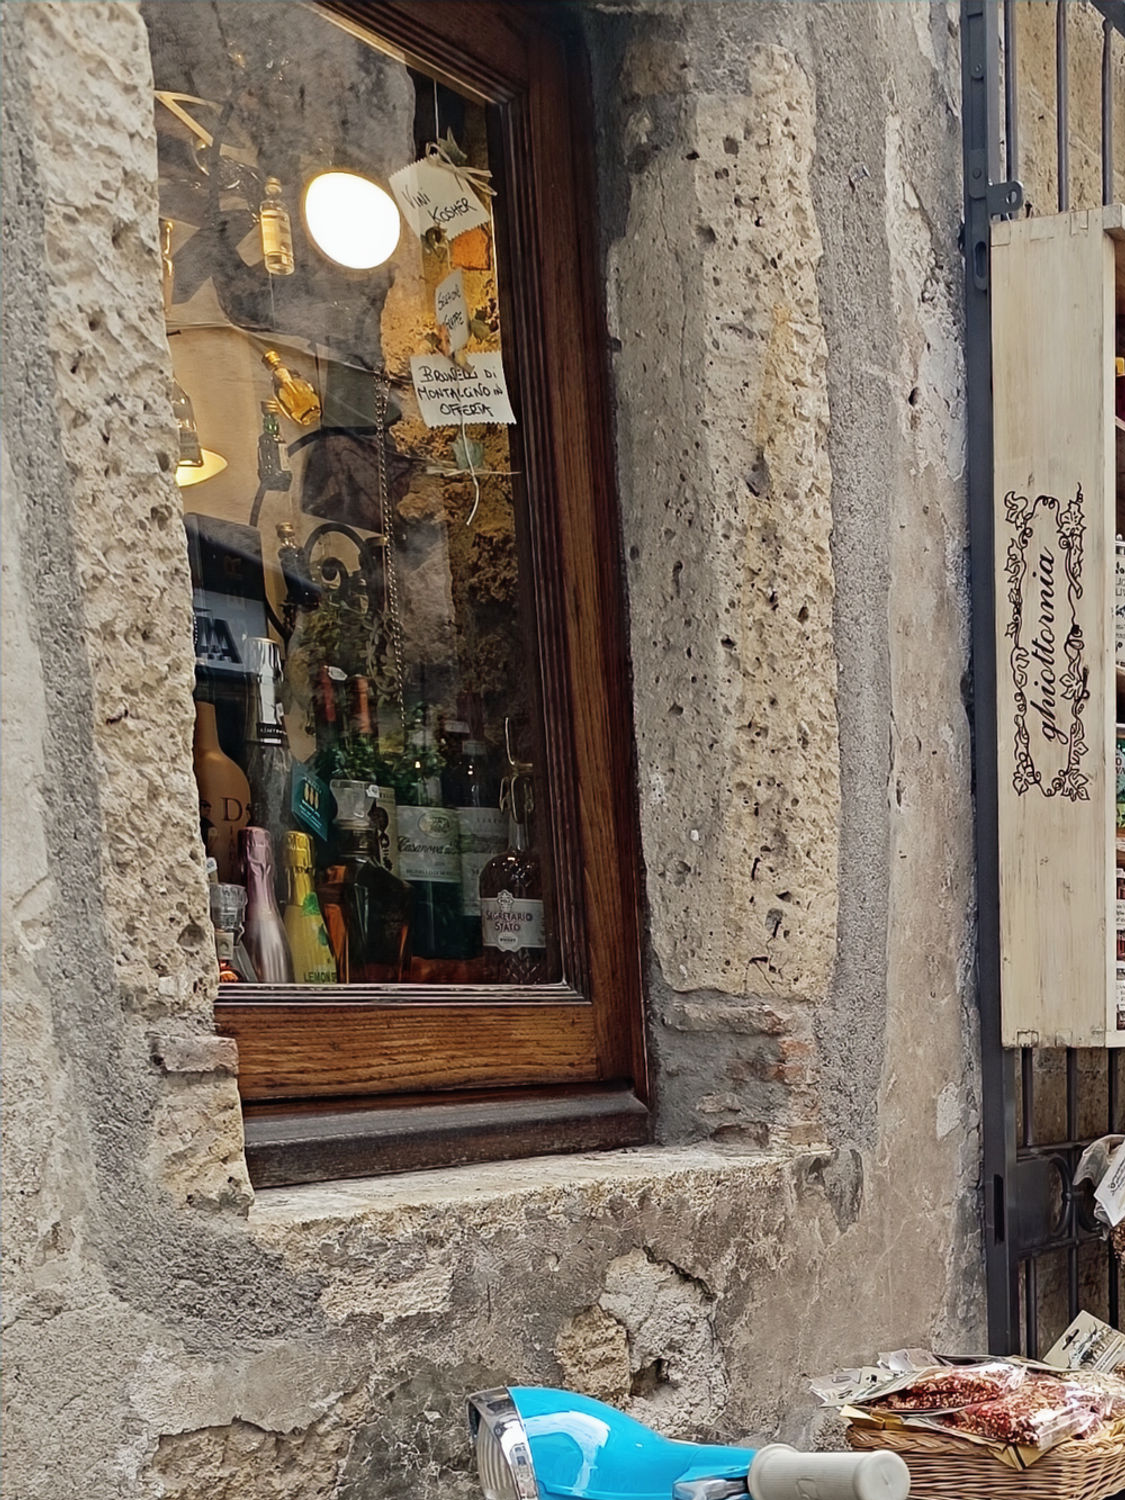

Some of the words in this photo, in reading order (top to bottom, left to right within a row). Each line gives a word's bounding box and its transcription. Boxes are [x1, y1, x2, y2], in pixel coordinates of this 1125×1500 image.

[402, 185, 431, 209] VINI
[428, 197, 477, 224] KOSHER
[440, 402, 493, 417] OFFERTA
[485, 911, 533, 923] SEGRETARIO
